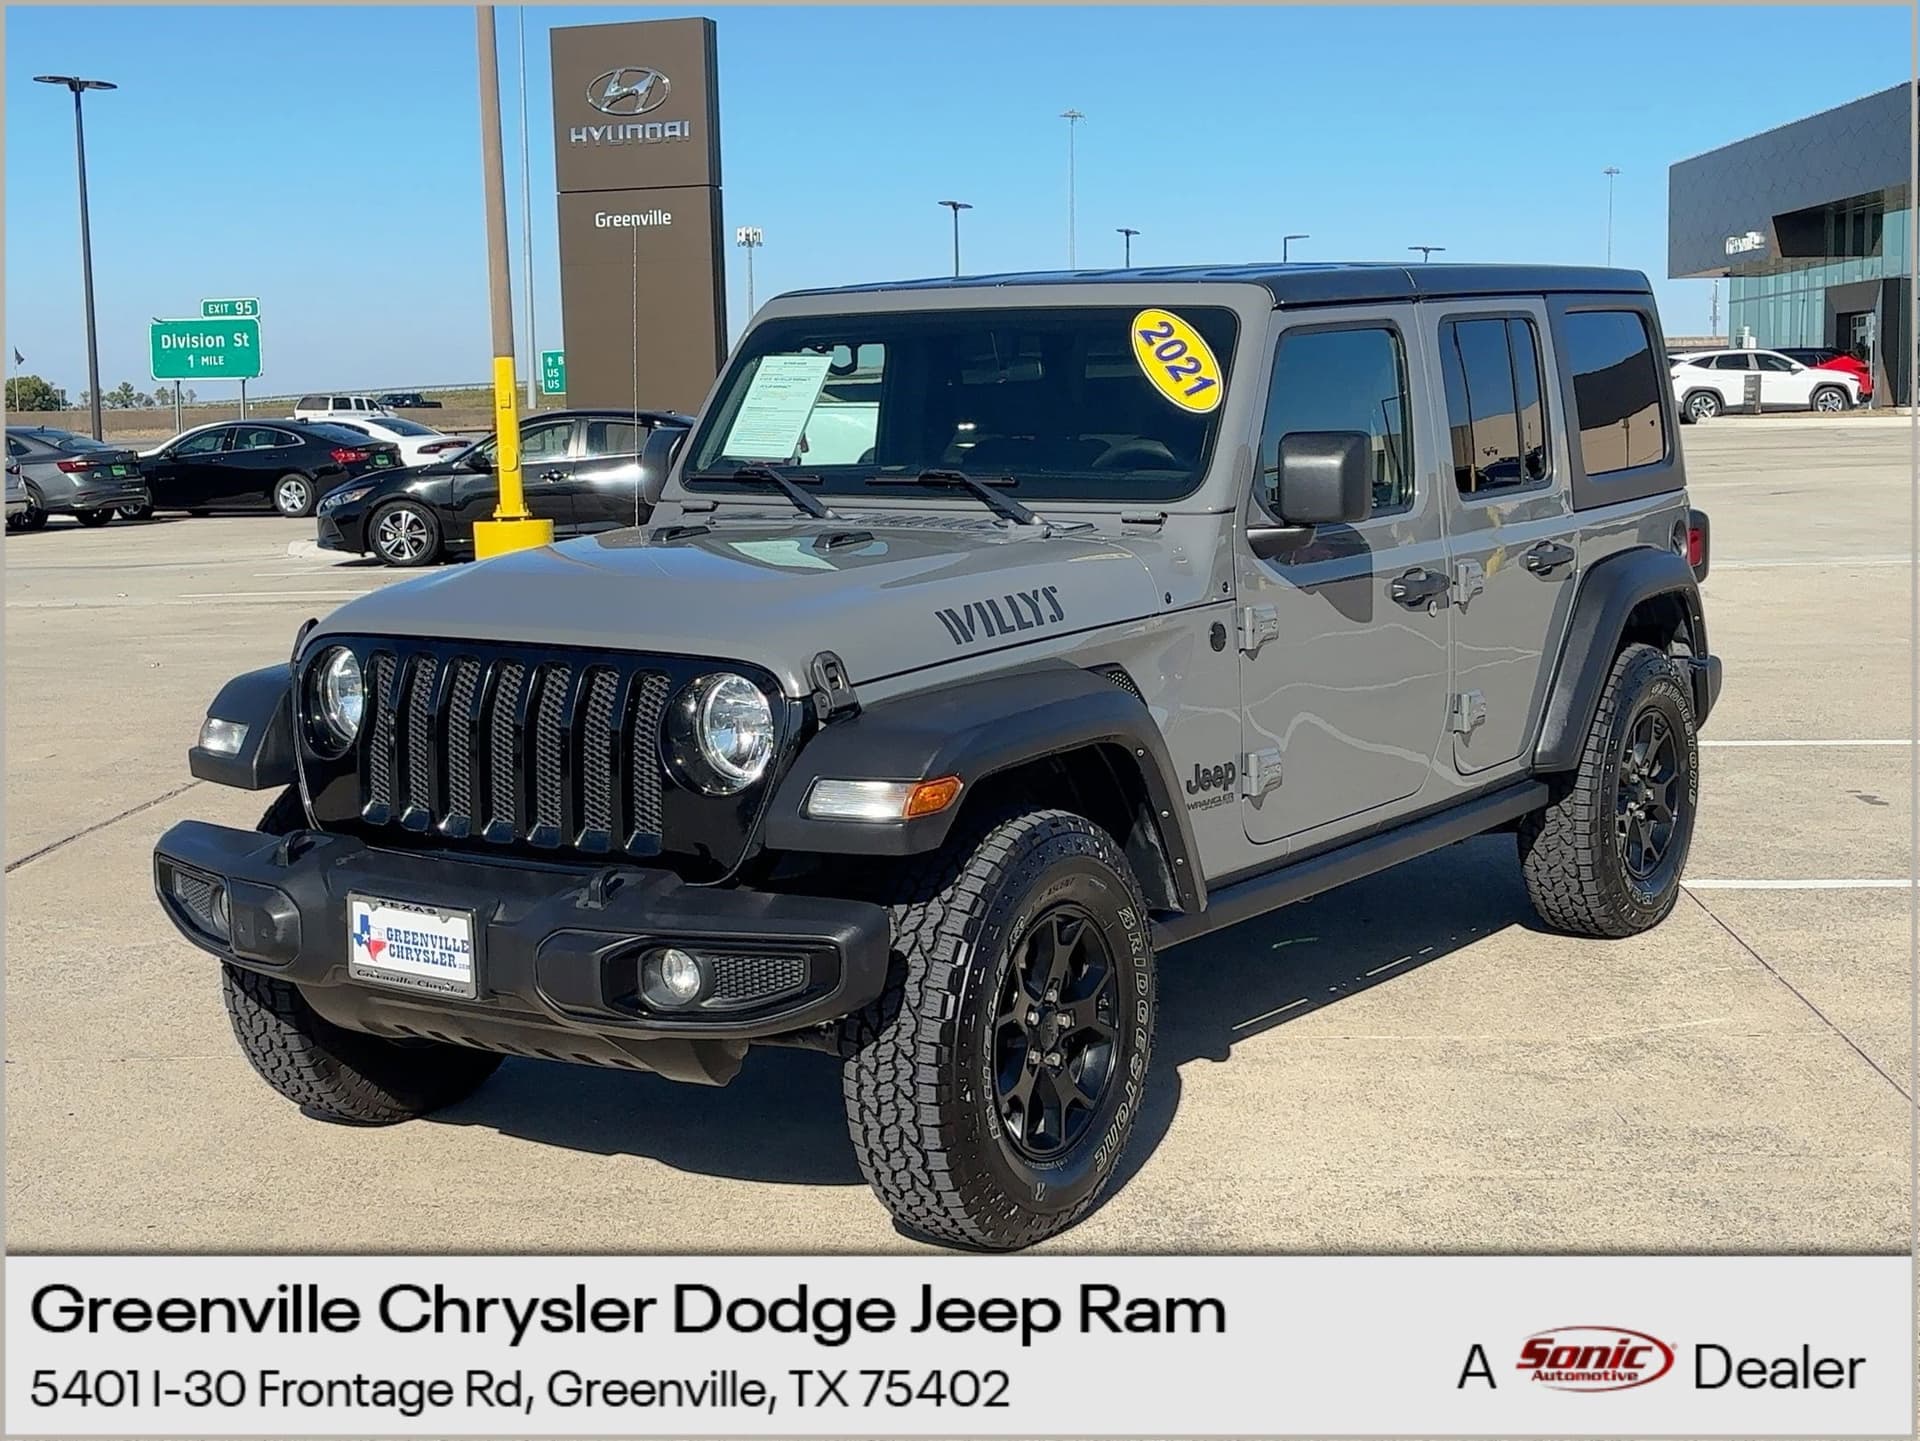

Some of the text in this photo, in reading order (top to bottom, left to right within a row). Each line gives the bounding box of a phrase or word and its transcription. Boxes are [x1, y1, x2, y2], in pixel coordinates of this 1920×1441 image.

[570, 120, 690, 144] HYUNDAI
[595, 209, 672, 228] Greenville
[208, 301, 252, 315] EXIT 95
[161, 332, 250, 349] Division St
[187, 354, 225, 369] 1 MILE
[1138, 320, 1217, 397] 2021
[547, 368, 559, 378] US
[547, 379, 560, 389] US
[935, 585, 1065, 645] WILLYS
[1186, 761, 1236, 794] Jeep
[378, 900, 438, 915] TEXAS
[386, 927, 470, 953] GREENVILLE
[388, 943, 457, 968] CHRYSLER
[1093, 905, 1150, 1172] BRIDGESTONE
